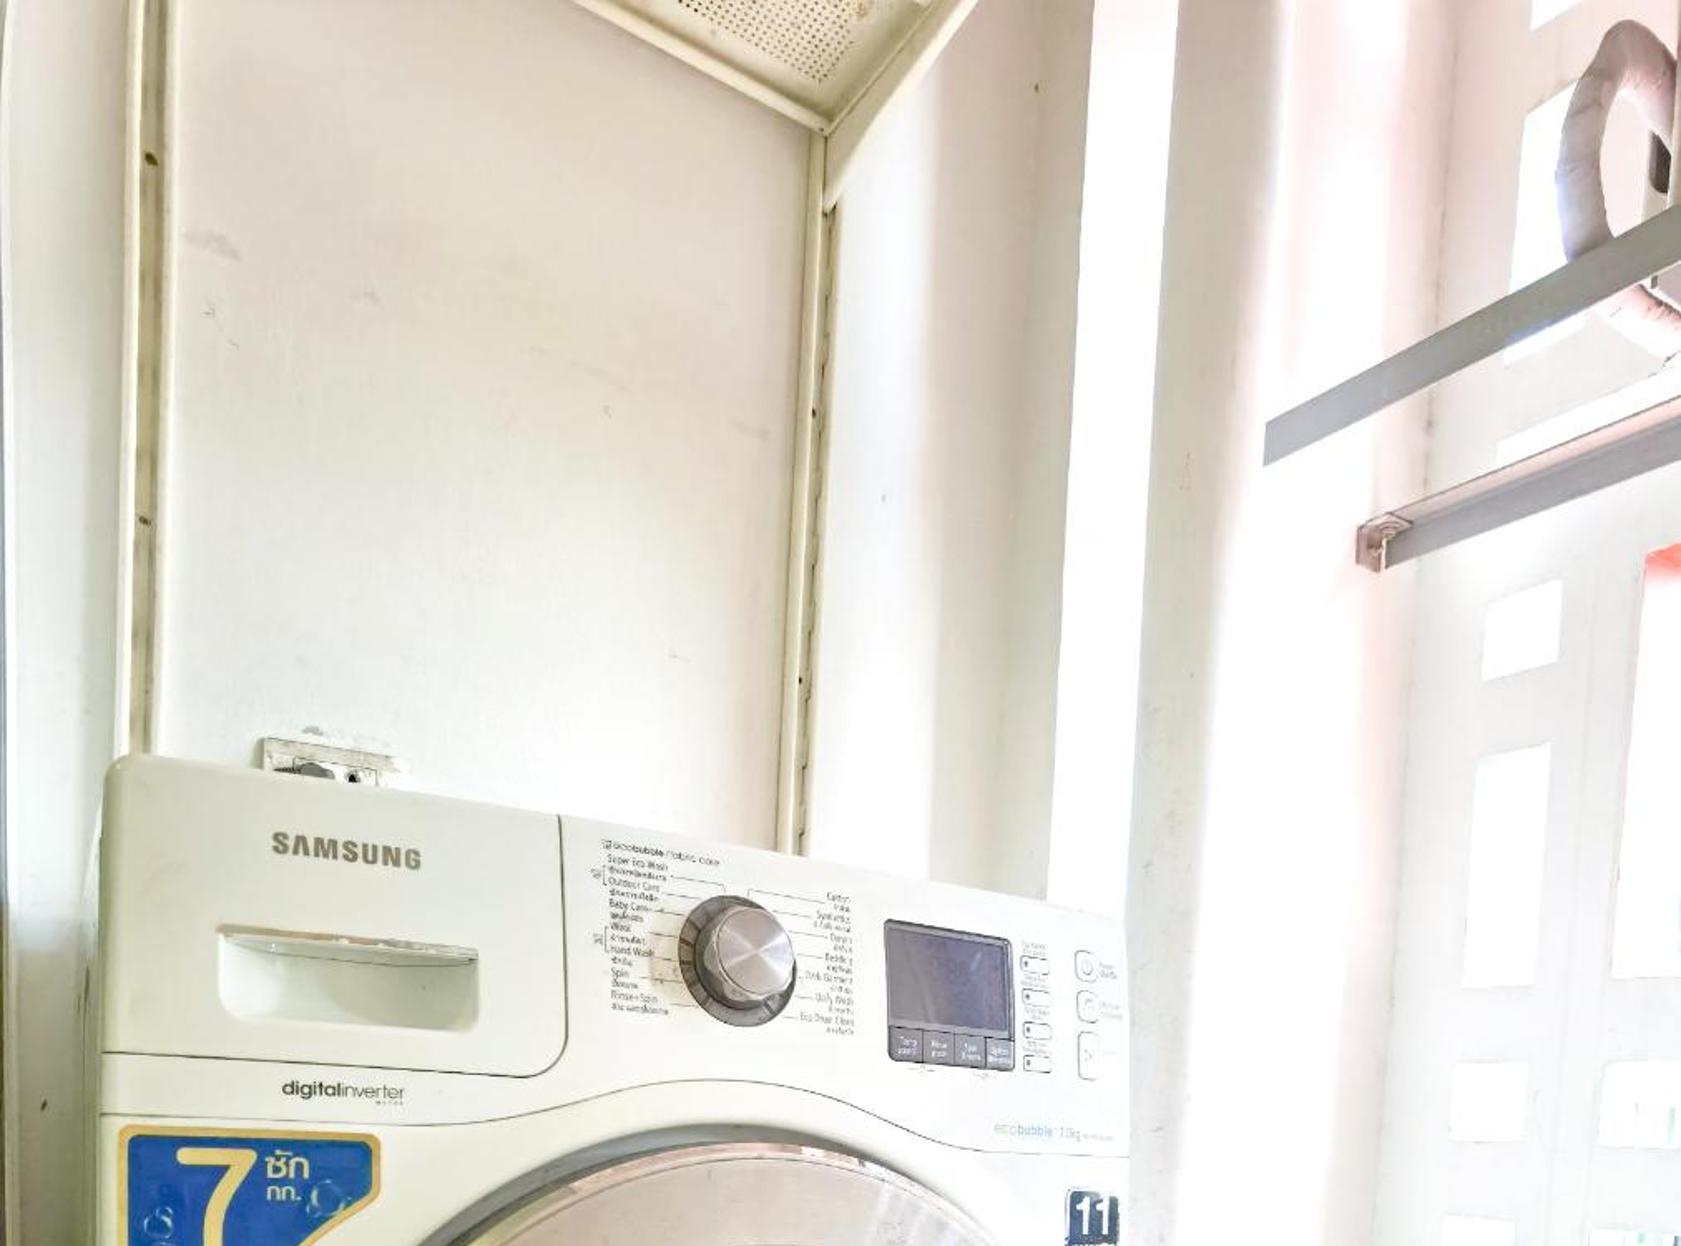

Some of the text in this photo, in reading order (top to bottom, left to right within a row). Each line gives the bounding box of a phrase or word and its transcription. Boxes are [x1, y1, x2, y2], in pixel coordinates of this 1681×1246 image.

[272, 831, 422, 870] SAMSUNG
[611, 967, 629, 979] Spin
[266, 1185, 302, 1202] กก.
[1076, 1195, 1110, 1236] 11
